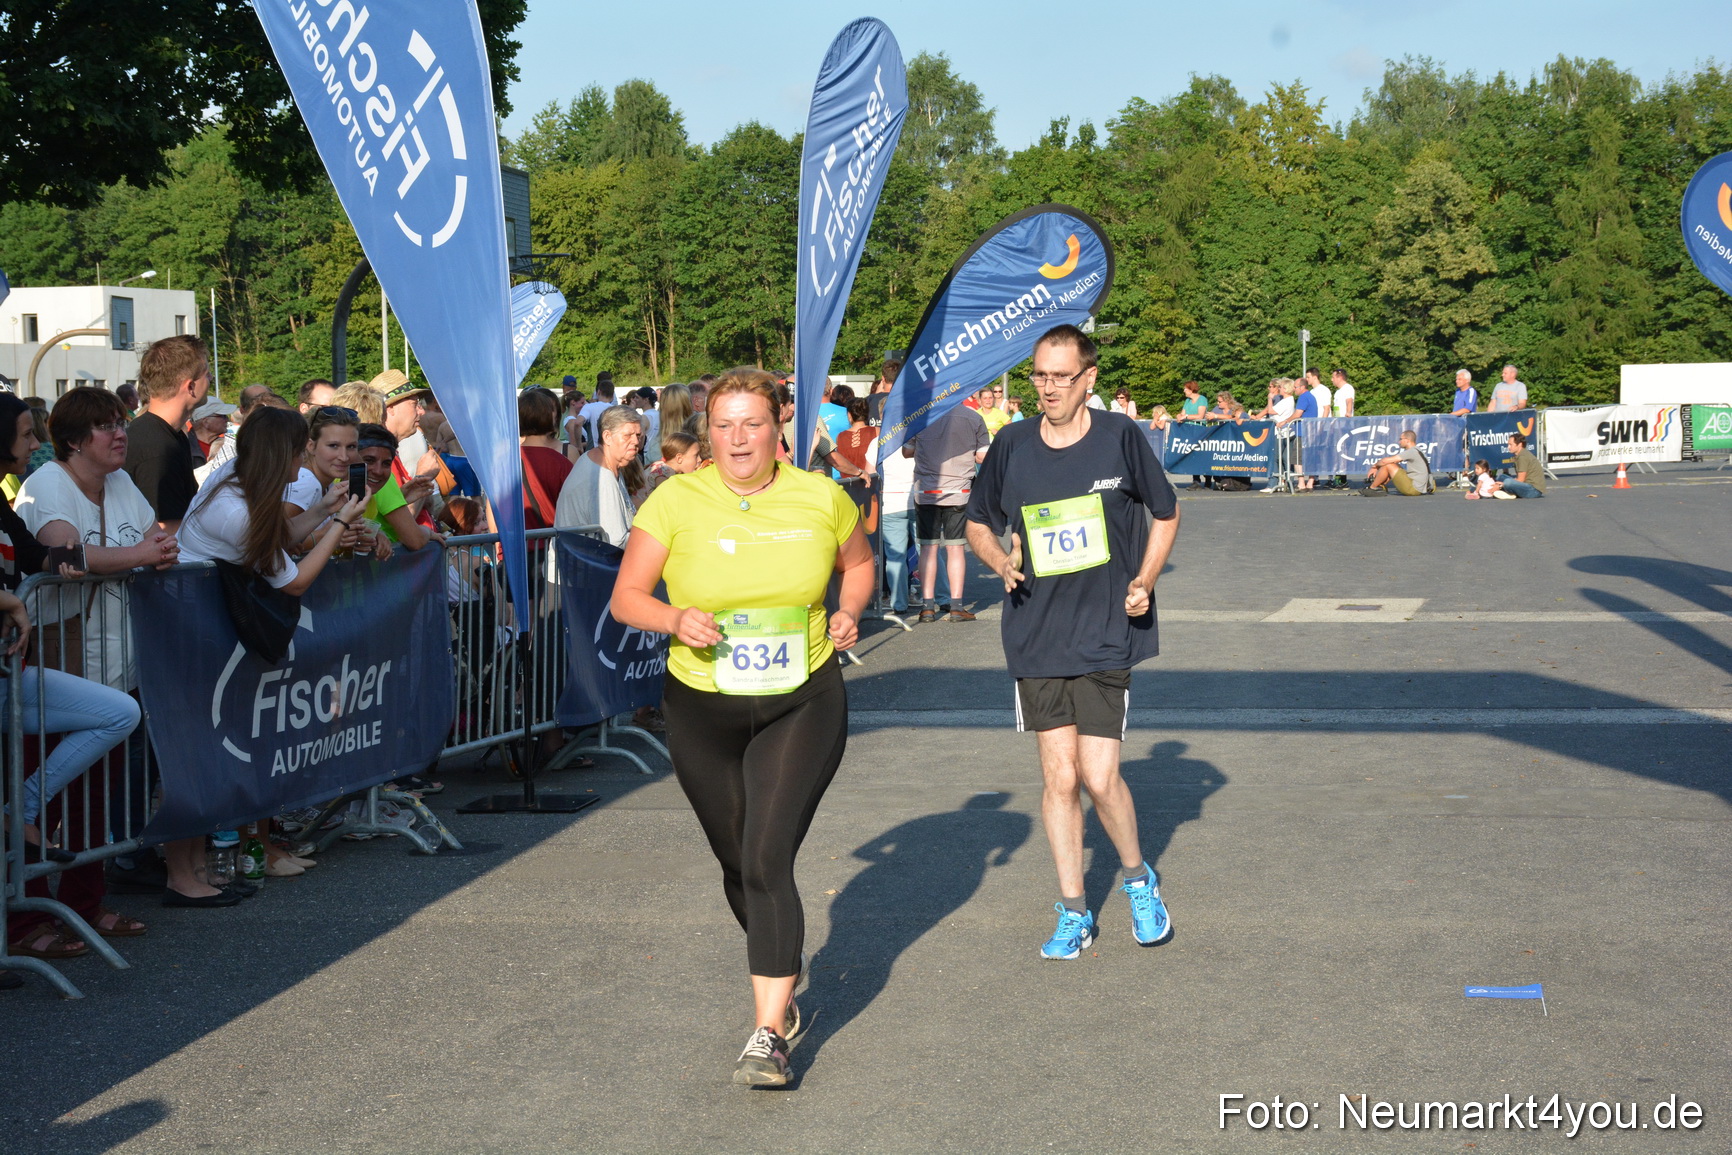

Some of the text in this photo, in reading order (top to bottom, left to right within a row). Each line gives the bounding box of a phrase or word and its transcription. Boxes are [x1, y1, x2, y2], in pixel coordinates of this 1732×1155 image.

[824, 64, 885, 262] Fischer
[843, 102, 892, 259] AUTOMOBILE
[513, 295, 548, 353] scher
[1002, 271, 1101, 341] Druck und Medien
[518, 307, 554, 360] AUTOMOBILE
[913, 283, 1052, 382] Frischmann
[877, 381, 961, 448] ww.frischmann-net.de
[1596, 417, 1649, 446] swn
[1700, 412, 1732, 433] AO
[1213, 453, 1268, 462] Druck und Medien
[1355, 440, 1438, 457] Fiscer
[1470, 428, 1519, 447] Frischma
[1635, 444, 1665, 454] neumarkt
[1042, 526, 1088, 555] 761
[727, 623, 762, 631] firmenlauf
[732, 641, 790, 671] 634
[251, 653, 392, 739] Fischer
[270, 720, 382, 778] AUTOMOBILE
